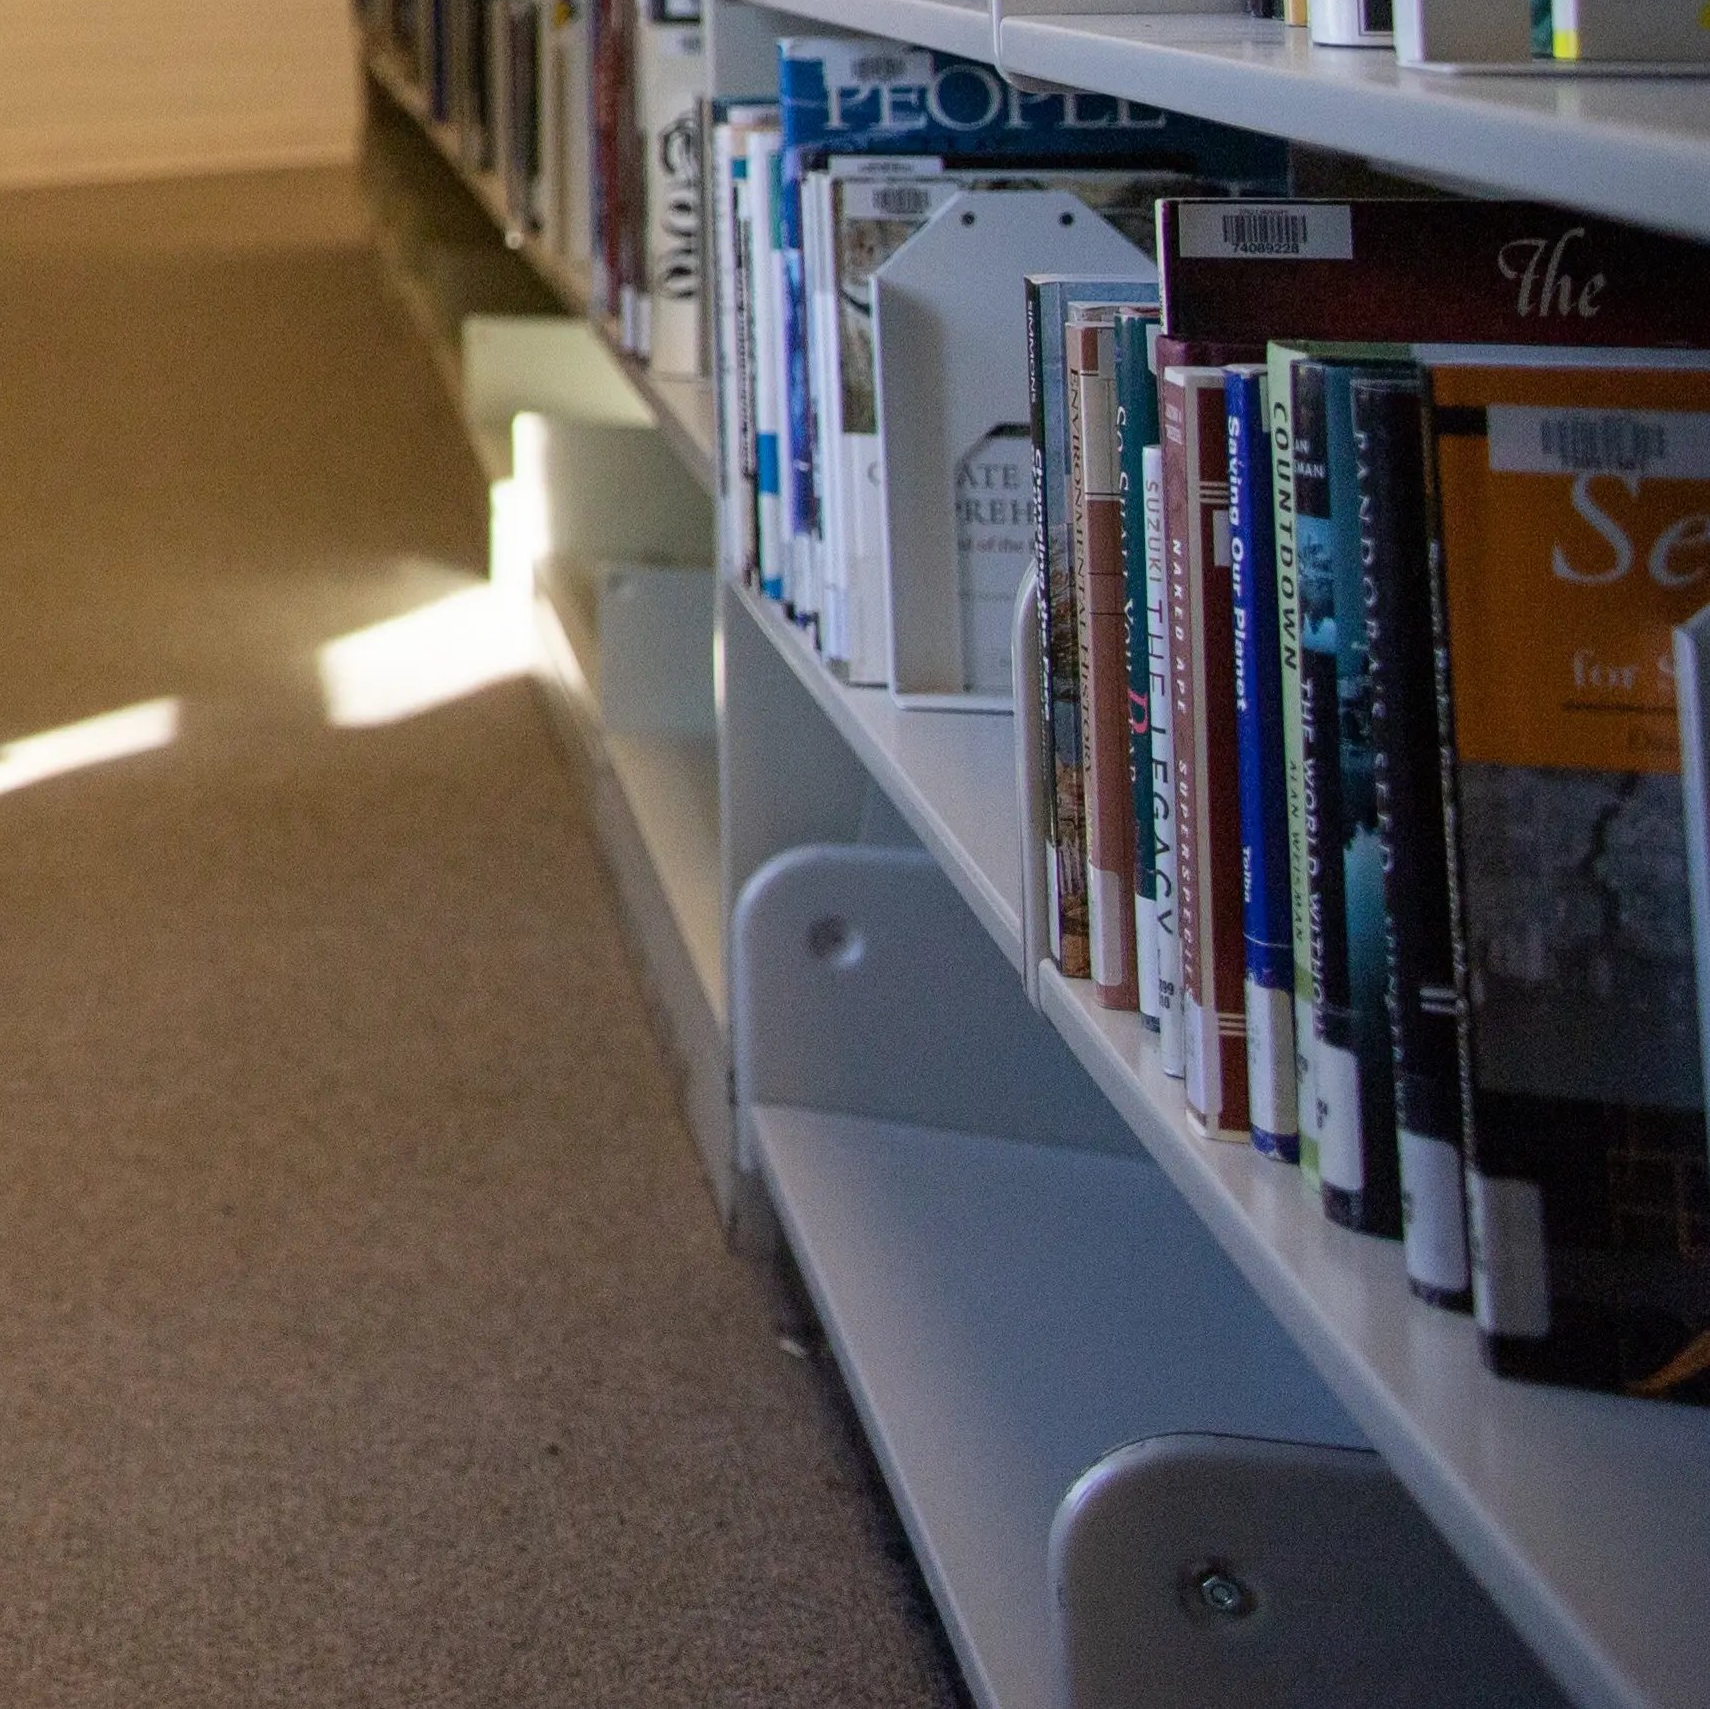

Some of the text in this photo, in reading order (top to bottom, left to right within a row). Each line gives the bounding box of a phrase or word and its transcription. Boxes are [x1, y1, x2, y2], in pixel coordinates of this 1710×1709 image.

[1028, 300, 1037, 403] SIMMONS
[1497, 227, 1606, 317] The
[957, 462, 1019, 490] ATE
[1294, 440, 1311, 455] AN
[1034, 448, 1046, 590] Changing
[1040, 600, 1049, 647] the
[1070, 368, 1087, 632] ENVIRONMENTAL
[1080, 643, 1092, 778] HISTORY
[1273, 401, 1297, 670] COUNTDOWN
[1147, 481, 1173, 935] SUZUKI THE LEGACY
[1173, 540, 1187, 713] NAKED APE
[1227, 415, 1253, 903] Saving Our Planet Tolba
[1301, 679, 1316, 742] THE
[1290, 761, 1303, 941] ALAN WEISMAN
[1303, 759, 1320, 876] WORLD
